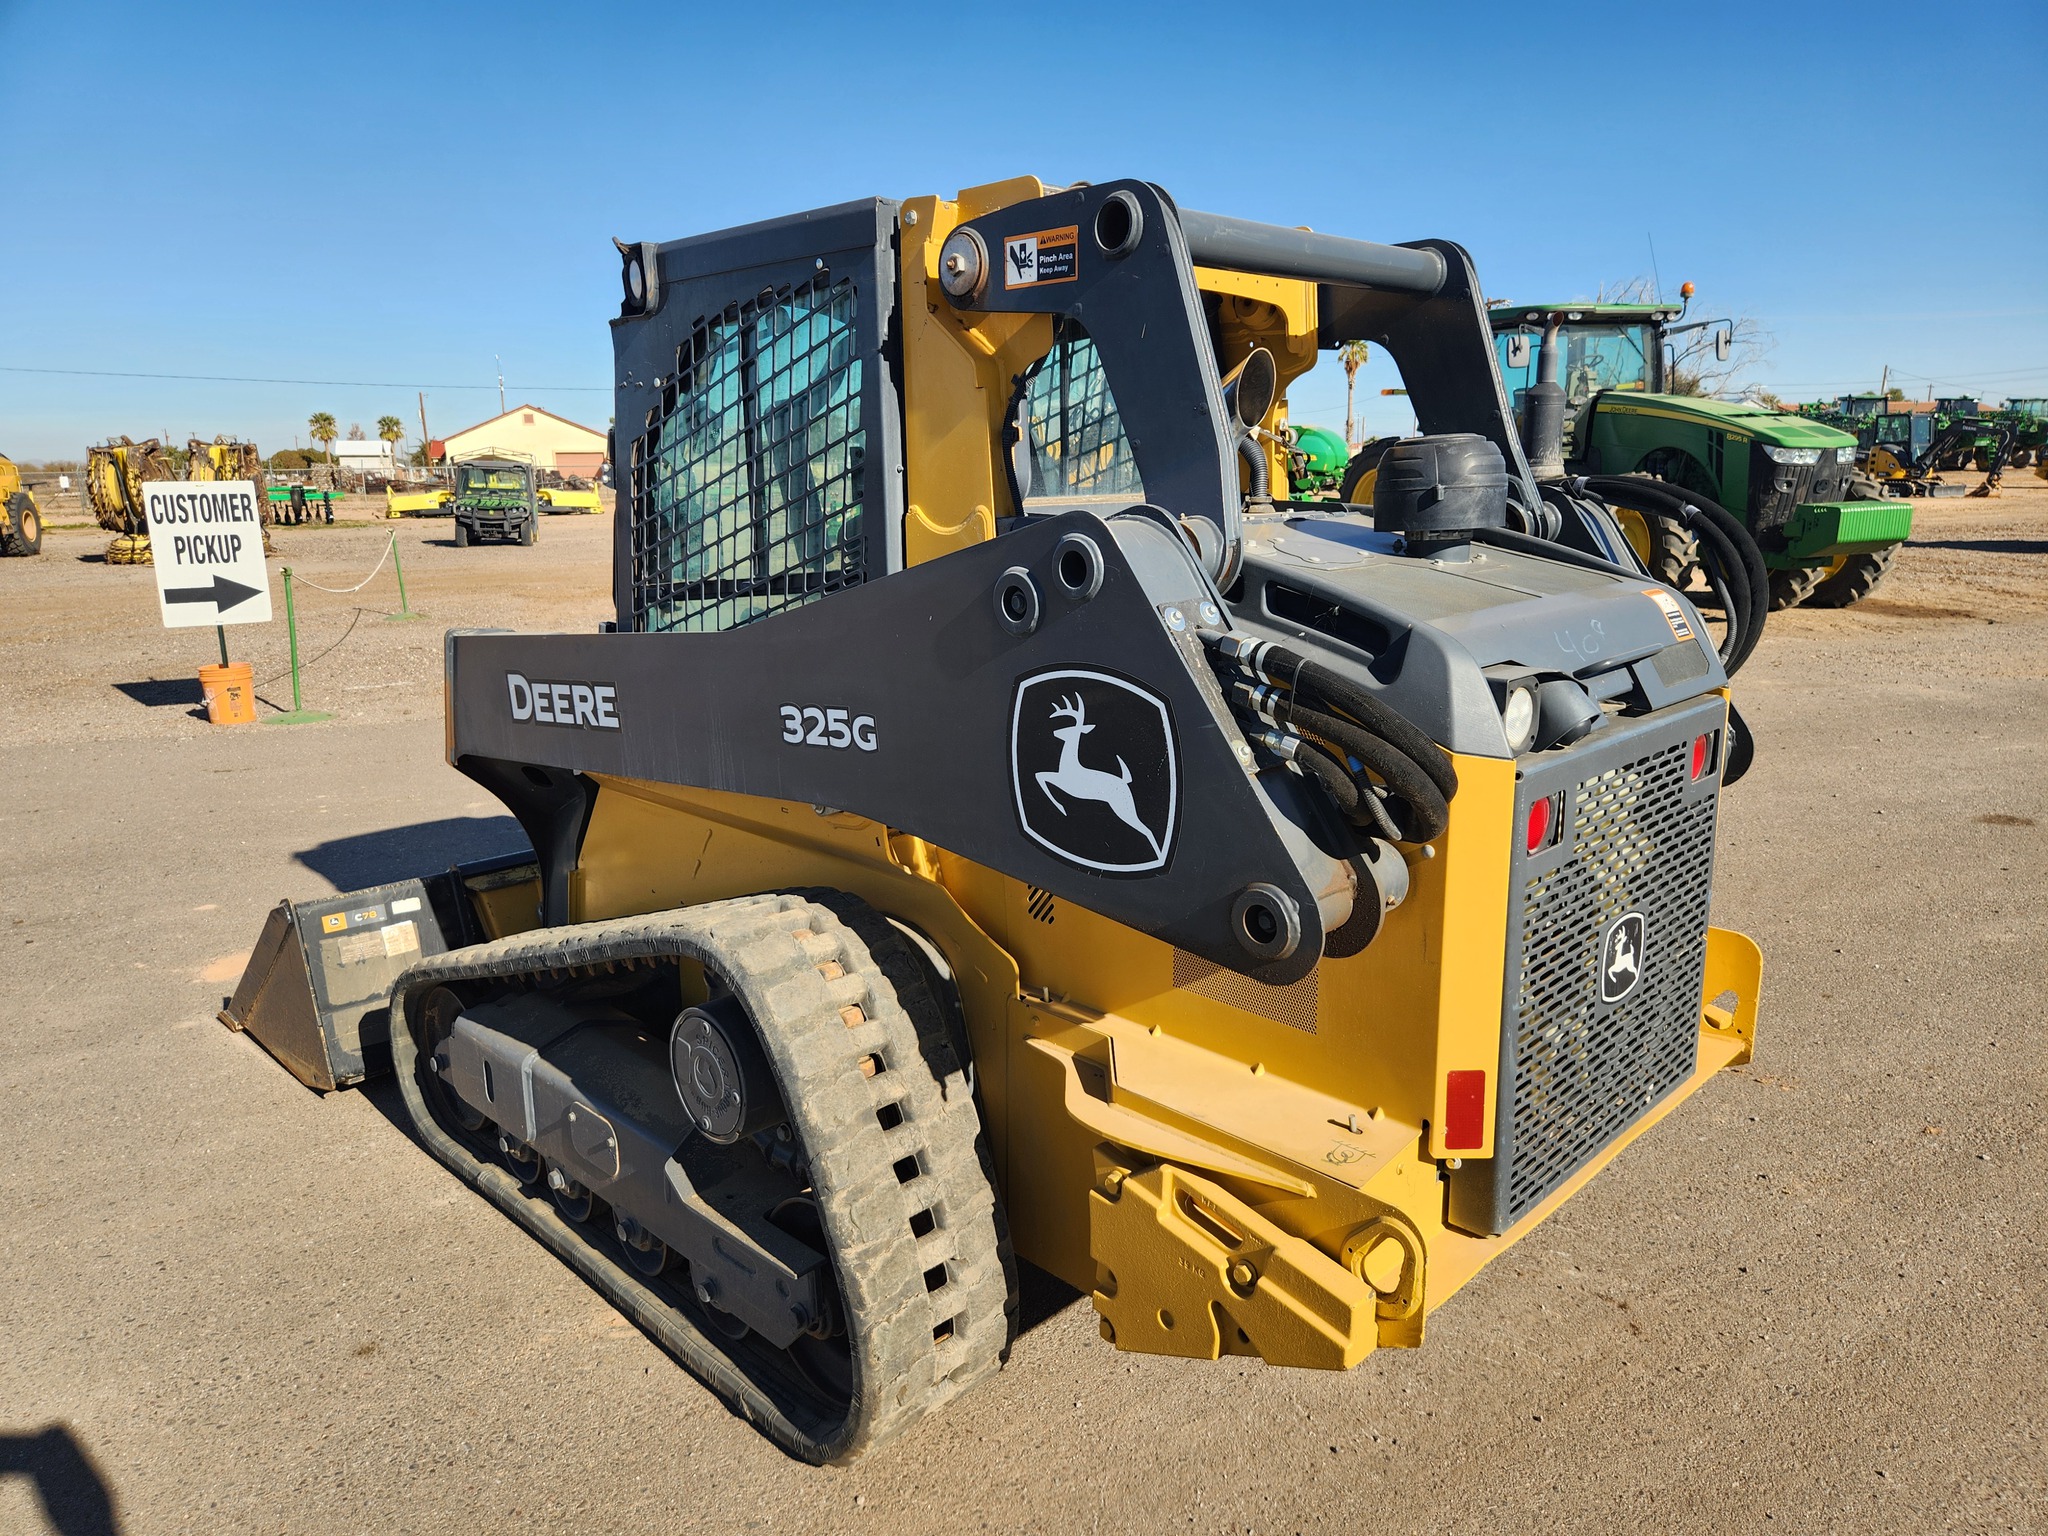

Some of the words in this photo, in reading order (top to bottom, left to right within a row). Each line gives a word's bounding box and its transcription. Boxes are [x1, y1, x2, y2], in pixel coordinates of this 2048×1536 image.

[1045, 231, 1075, 243] WARNING
[1039, 253, 1058, 264] Pinch
[1058, 251, 1074, 261] Area
[1039, 267, 1054, 275] Keep
[1053, 264, 1069, 273] Away
[1609, 406, 1622, 414] JOHN
[1622, 406, 1639, 415] DEERE
[150, 493, 255, 525] CUSTOMER
[173, 534, 242, 565] PICKUP
[507, 673, 620, 728] DEERE
[780, 705, 878, 751] 325G
[696, 1033, 730, 1079] SPICER
